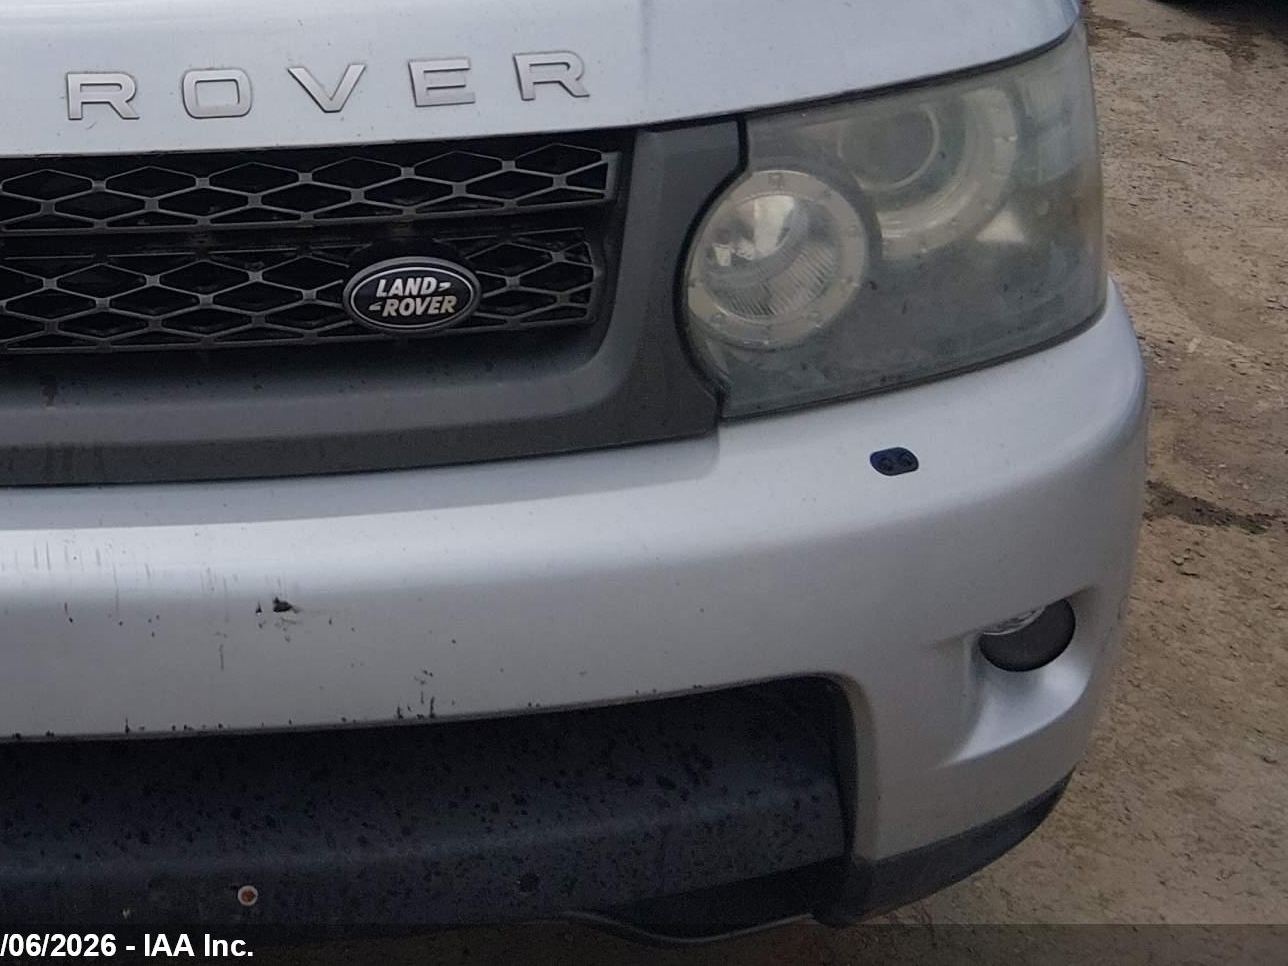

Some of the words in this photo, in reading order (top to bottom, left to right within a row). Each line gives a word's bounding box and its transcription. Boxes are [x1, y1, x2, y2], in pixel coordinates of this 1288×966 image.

[65, 50, 591, 121] ROVER
[375, 276, 438, 298] LAND
[382, 295, 458, 318] ROVER
